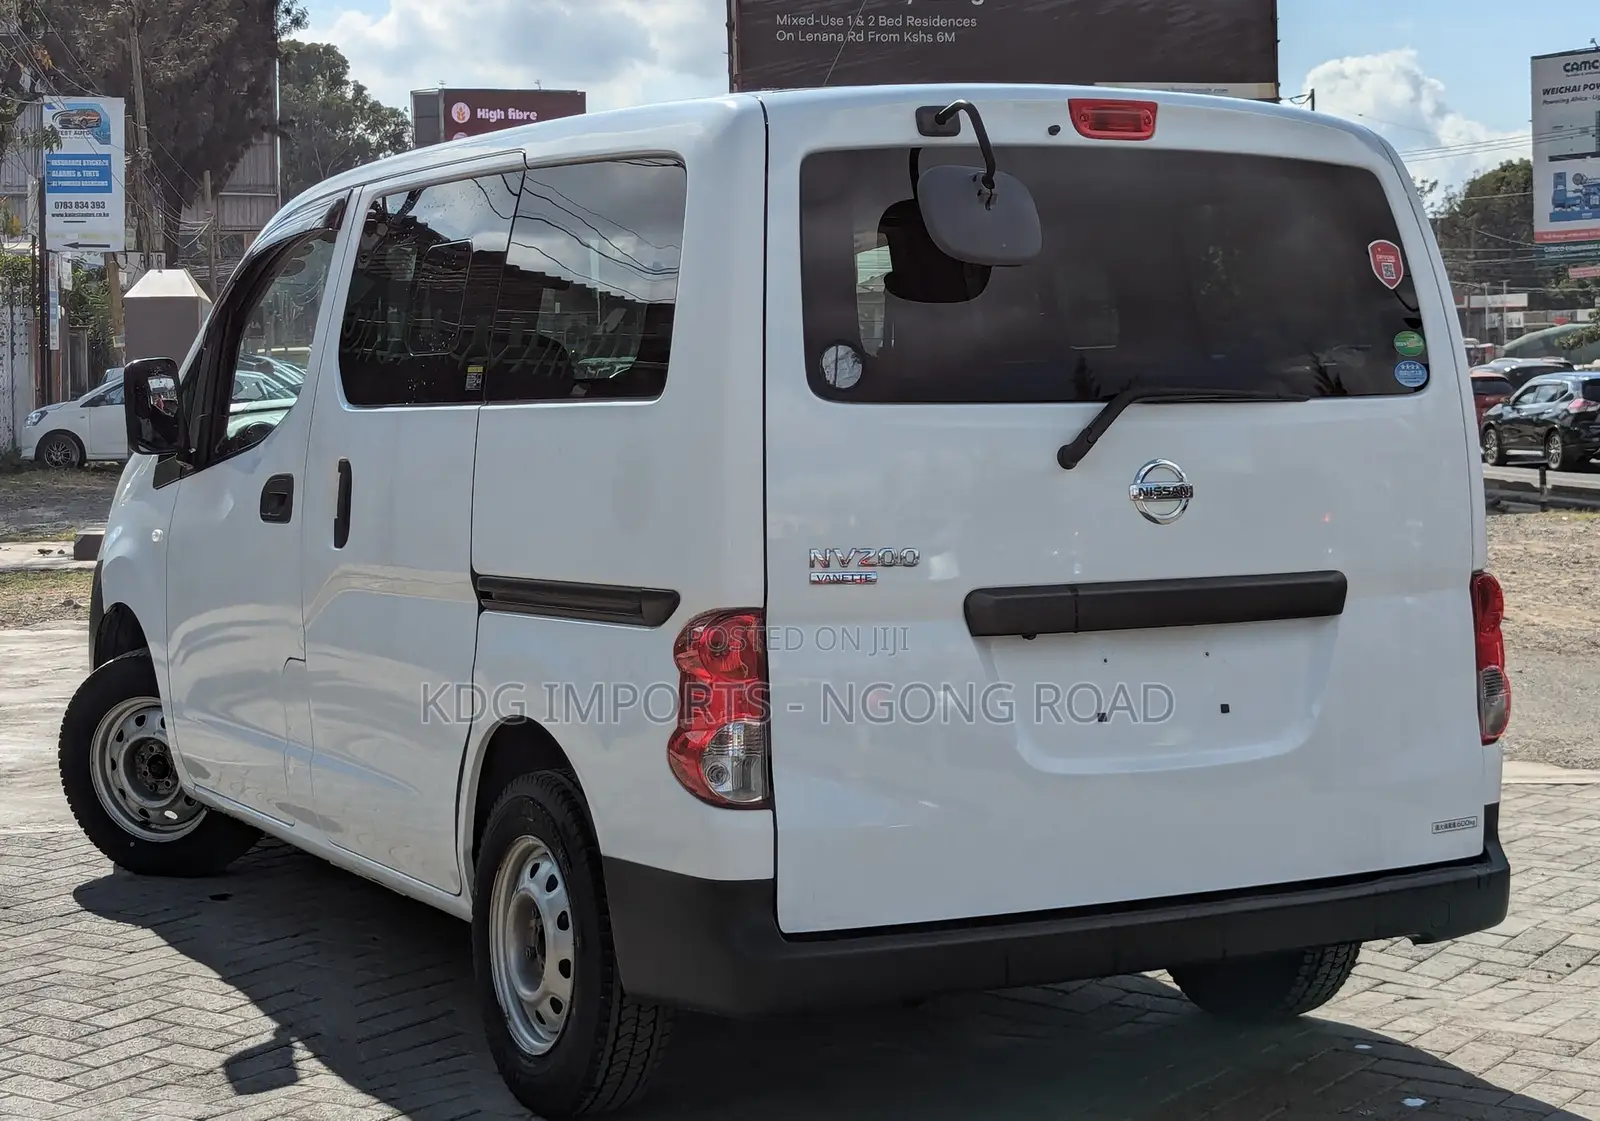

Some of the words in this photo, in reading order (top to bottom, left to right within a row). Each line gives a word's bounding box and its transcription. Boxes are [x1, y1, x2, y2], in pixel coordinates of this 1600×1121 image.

[776, 14, 844, 26] Mixed-Use
[847, 15, 852, 26] 1
[856, 15, 864, 26] &
[868, 16, 875, 27] 2
[878, 15, 902, 27] Bed
[906, 15, 977, 27] Residences
[776, 31, 794, 42] On
[799, 31, 844, 42] Lenana
[848, 31, 863, 42] Rd
[868, 31, 900, 42] From
[904, 31, 933, 42] Kshs
[937, 31, 956, 42] 6M
[1542, 85, 1581, 96] WEICHAI
[477, 108, 505, 122] High
[508, 108, 538, 121] fibre
[54, 201, 73, 209] 0783
[74, 201, 89, 209] 834
[90, 201, 106, 209] 393
[1138, 485, 1189, 497] NISSAN
[809, 547, 920, 568] NV200
[816, 573, 873, 582] VANETTE
